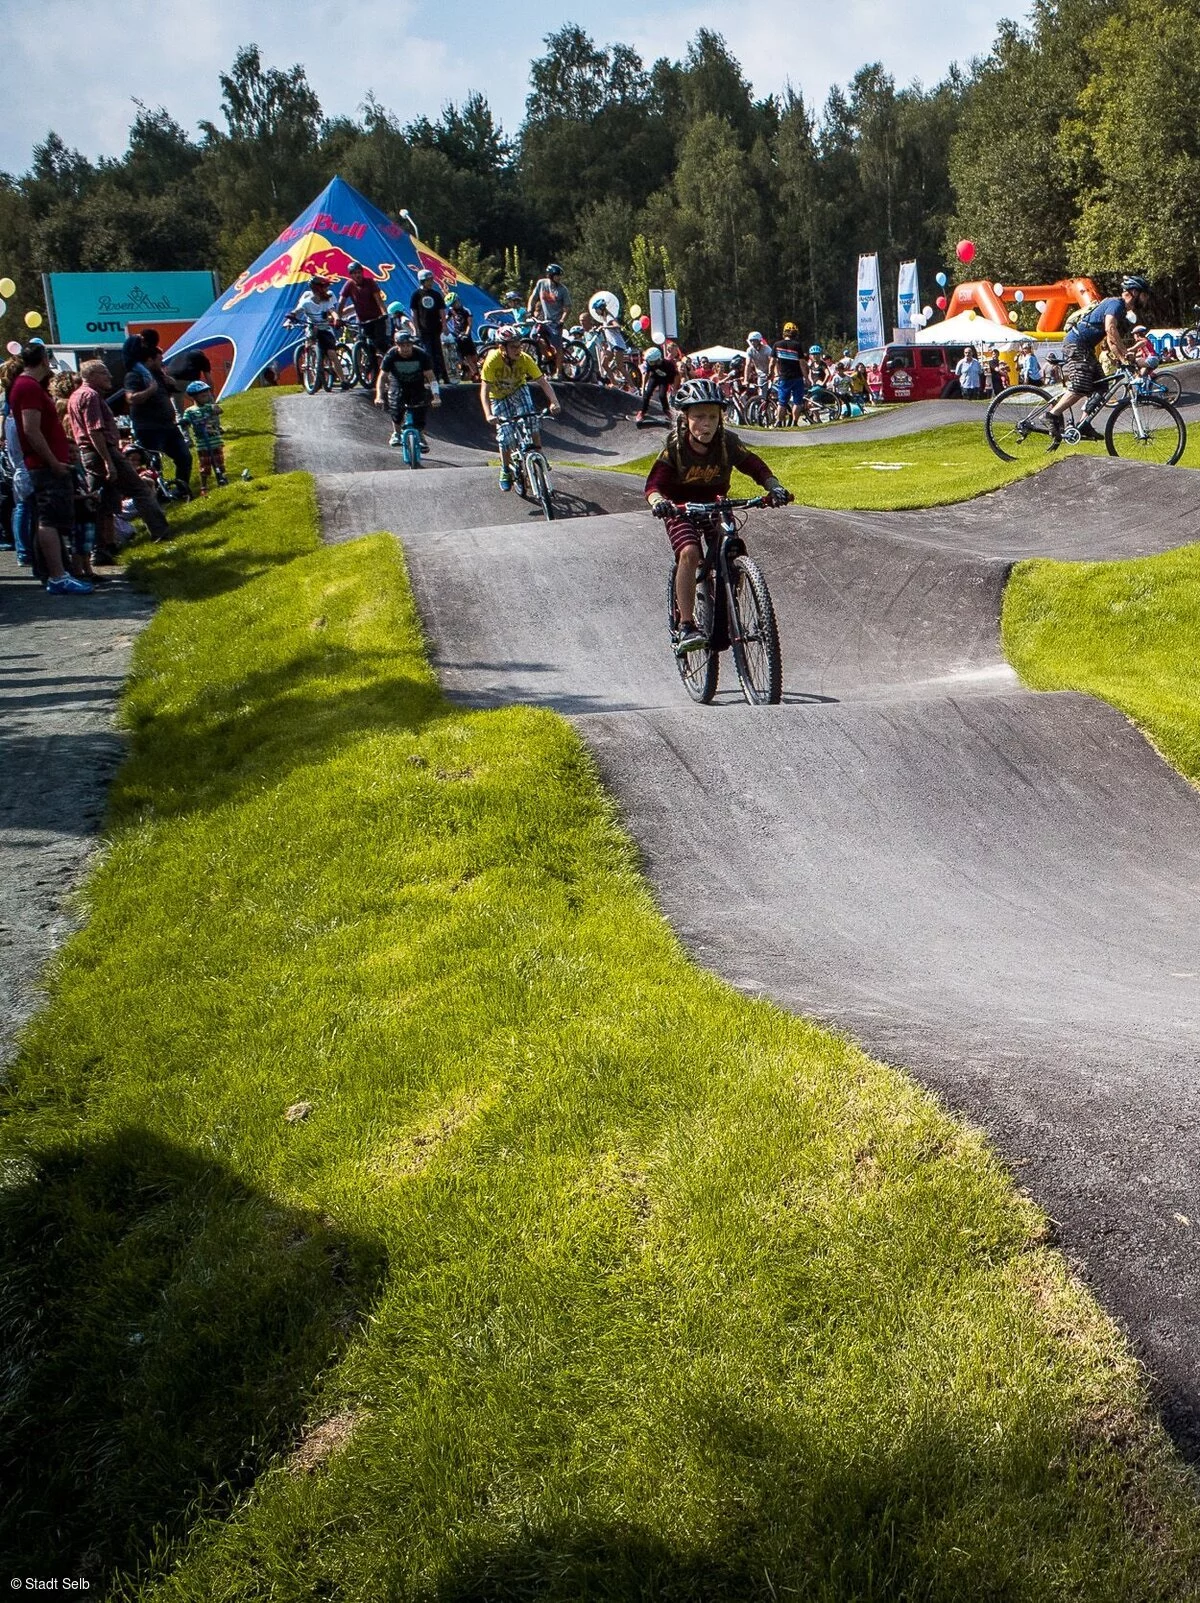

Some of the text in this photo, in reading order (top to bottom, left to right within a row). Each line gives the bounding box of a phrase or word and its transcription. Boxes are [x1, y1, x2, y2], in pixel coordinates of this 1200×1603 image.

[315, 213, 368, 239] Bull
[98, 293, 179, 314] Rosenthal
[86, 322, 125, 332] OUTL
